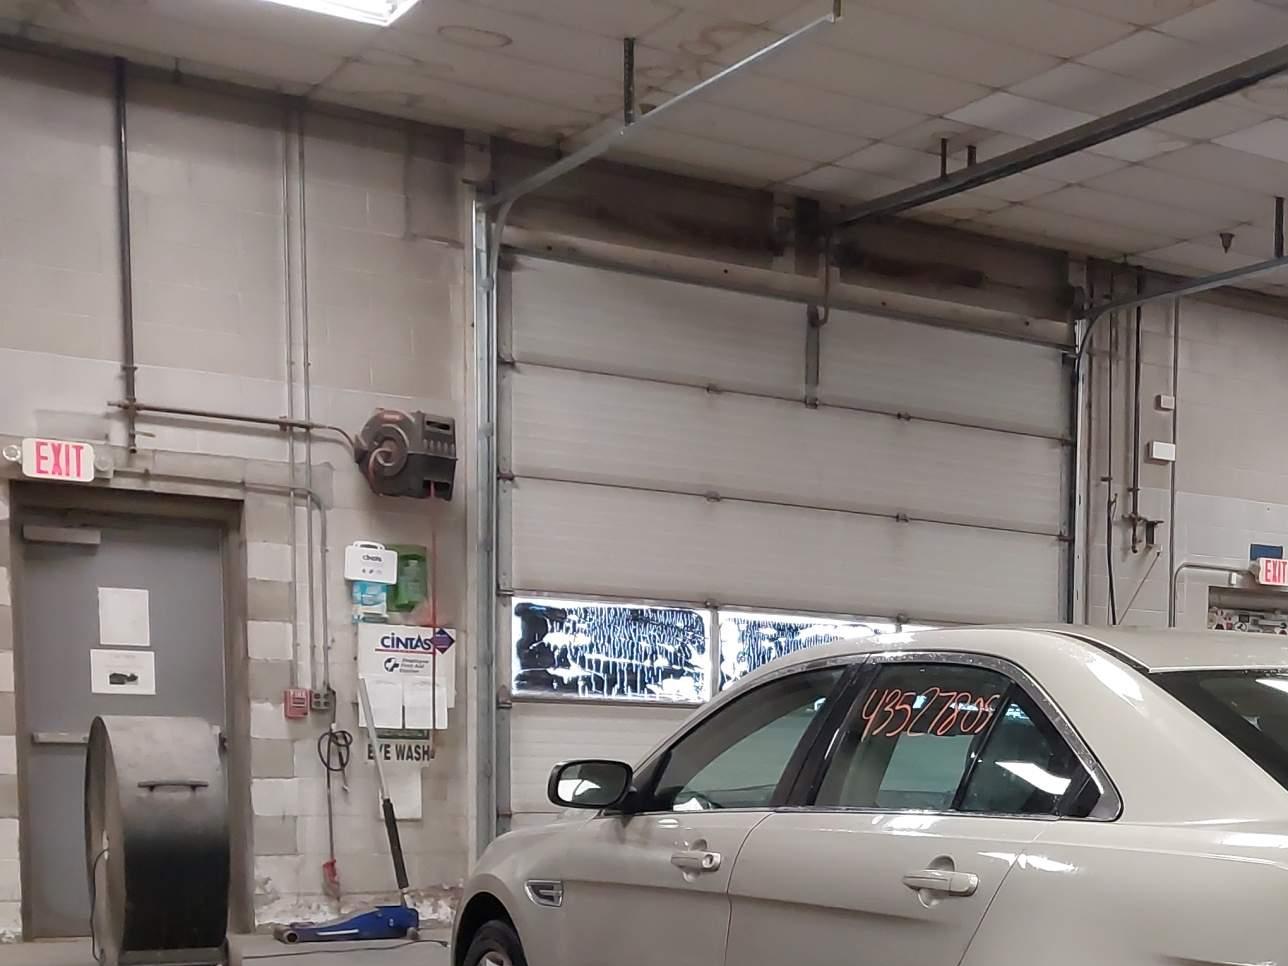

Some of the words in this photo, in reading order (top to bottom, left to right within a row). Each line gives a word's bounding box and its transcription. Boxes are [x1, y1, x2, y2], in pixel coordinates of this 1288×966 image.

[35, 441, 84, 478] EXIT
[1265, 559, 1288, 584] EXIT
[861, 687, 1001, 742] 43527805
[367, 743, 391, 760] EE
[395, 744, 430, 761] WASH
